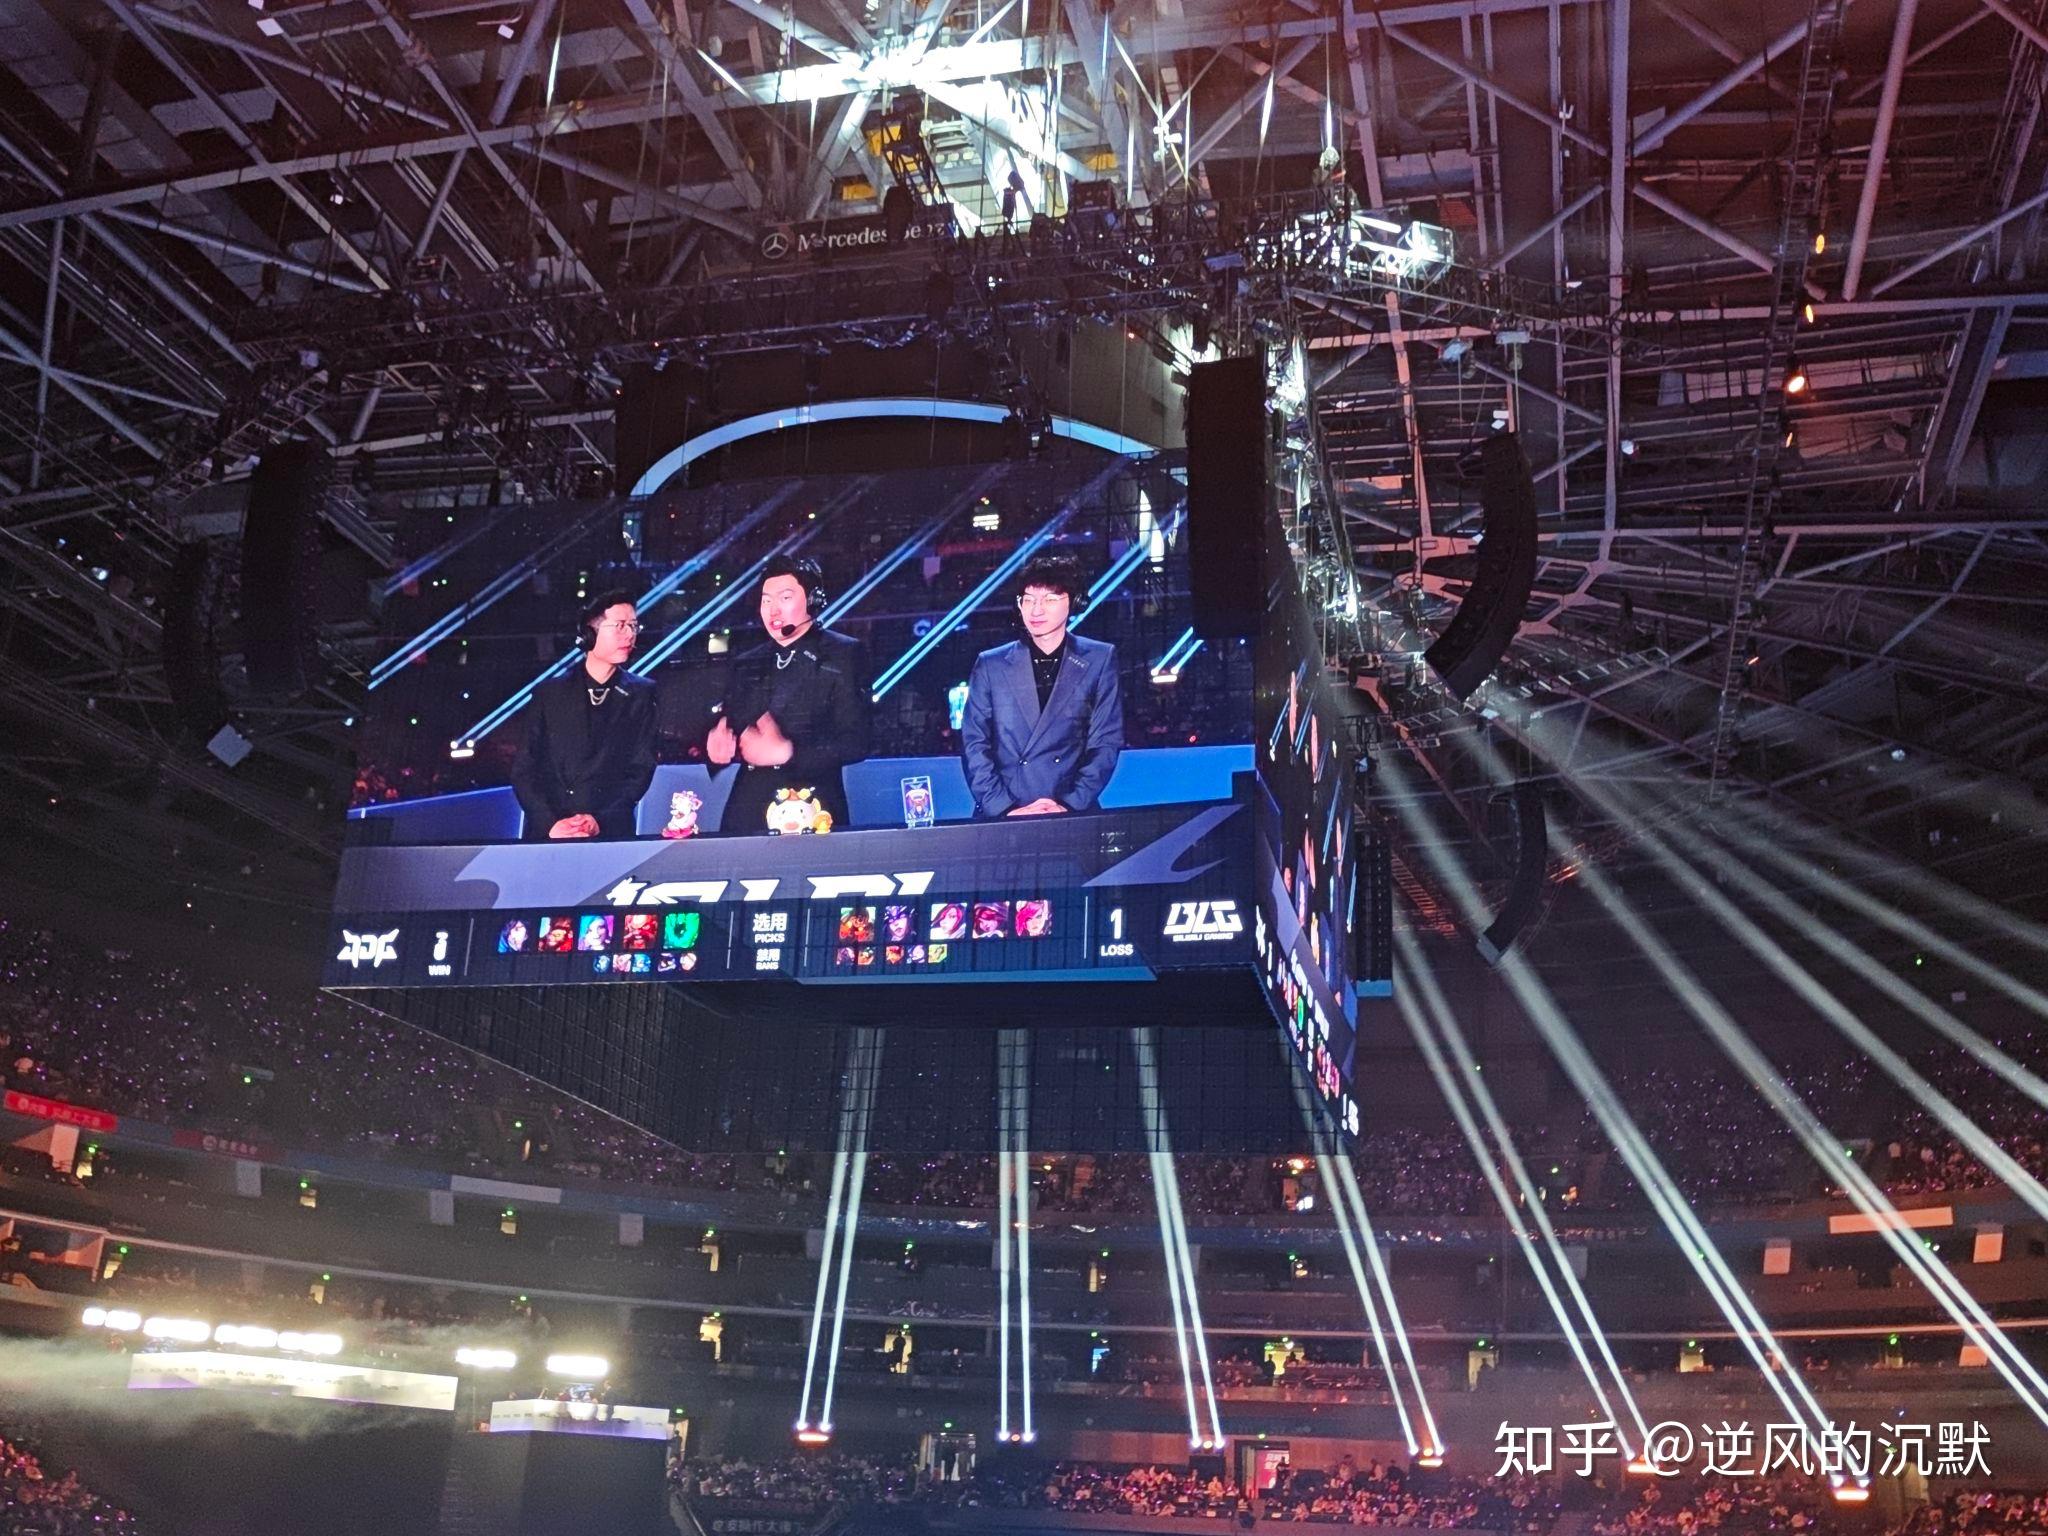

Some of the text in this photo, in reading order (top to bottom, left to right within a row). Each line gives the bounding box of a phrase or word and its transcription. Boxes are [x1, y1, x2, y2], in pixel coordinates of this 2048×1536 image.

[752, 912, 788, 932] 选用
[1110, 908, 1123, 940] 1
[754, 933, 786, 944] PICKS
[1100, 944, 1135, 957] LOSS
